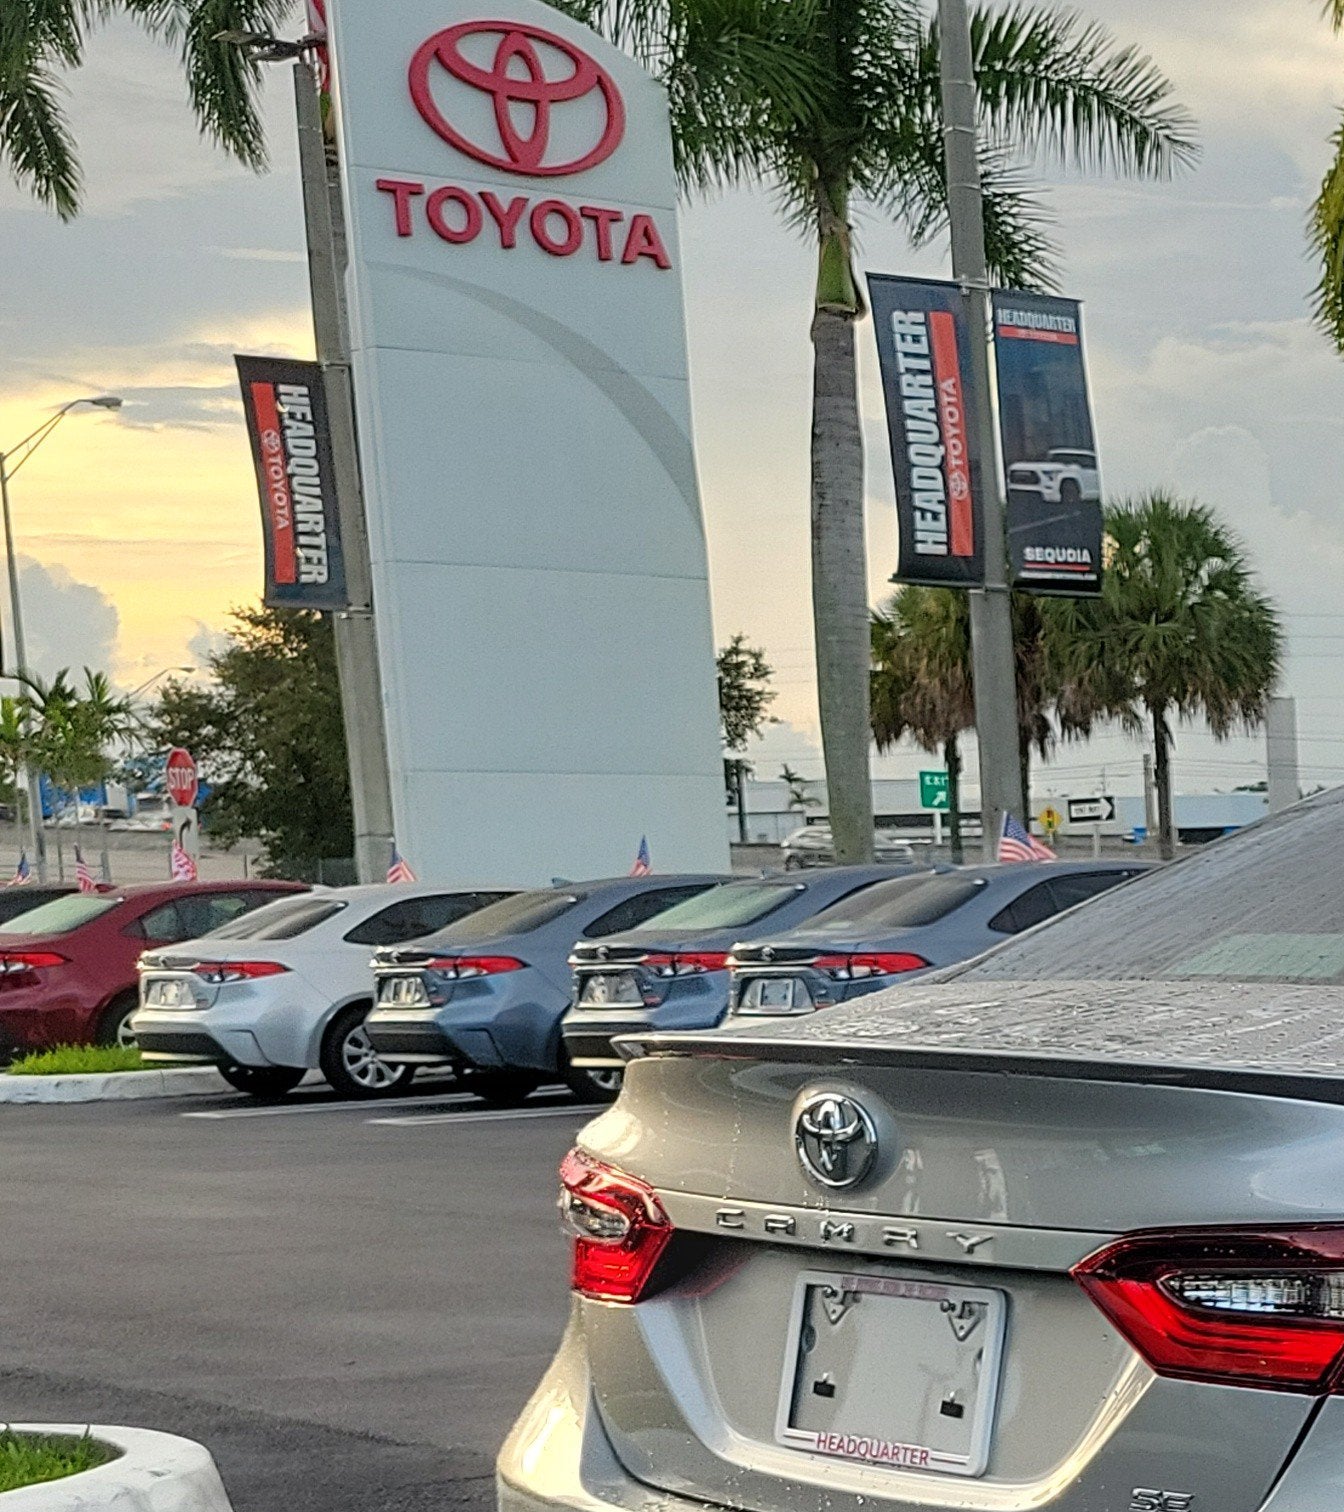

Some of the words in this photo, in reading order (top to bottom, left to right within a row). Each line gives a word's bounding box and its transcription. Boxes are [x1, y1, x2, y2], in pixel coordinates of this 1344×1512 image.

[376, 178, 672, 270] TOYOTA
[892, 310, 949, 556] HEADQUARTER
[938, 377, 971, 468] TOYOTA
[265, 455, 290, 530] TOYOTA
[276, 383, 329, 585] HEADQUARTER
[1023, 545, 1093, 564] SEQUOIA
[168, 766, 194, 790] STOP
[715, 1207, 994, 1254] CAMRY
[816, 1432, 930, 1466] HEADQUARTER
